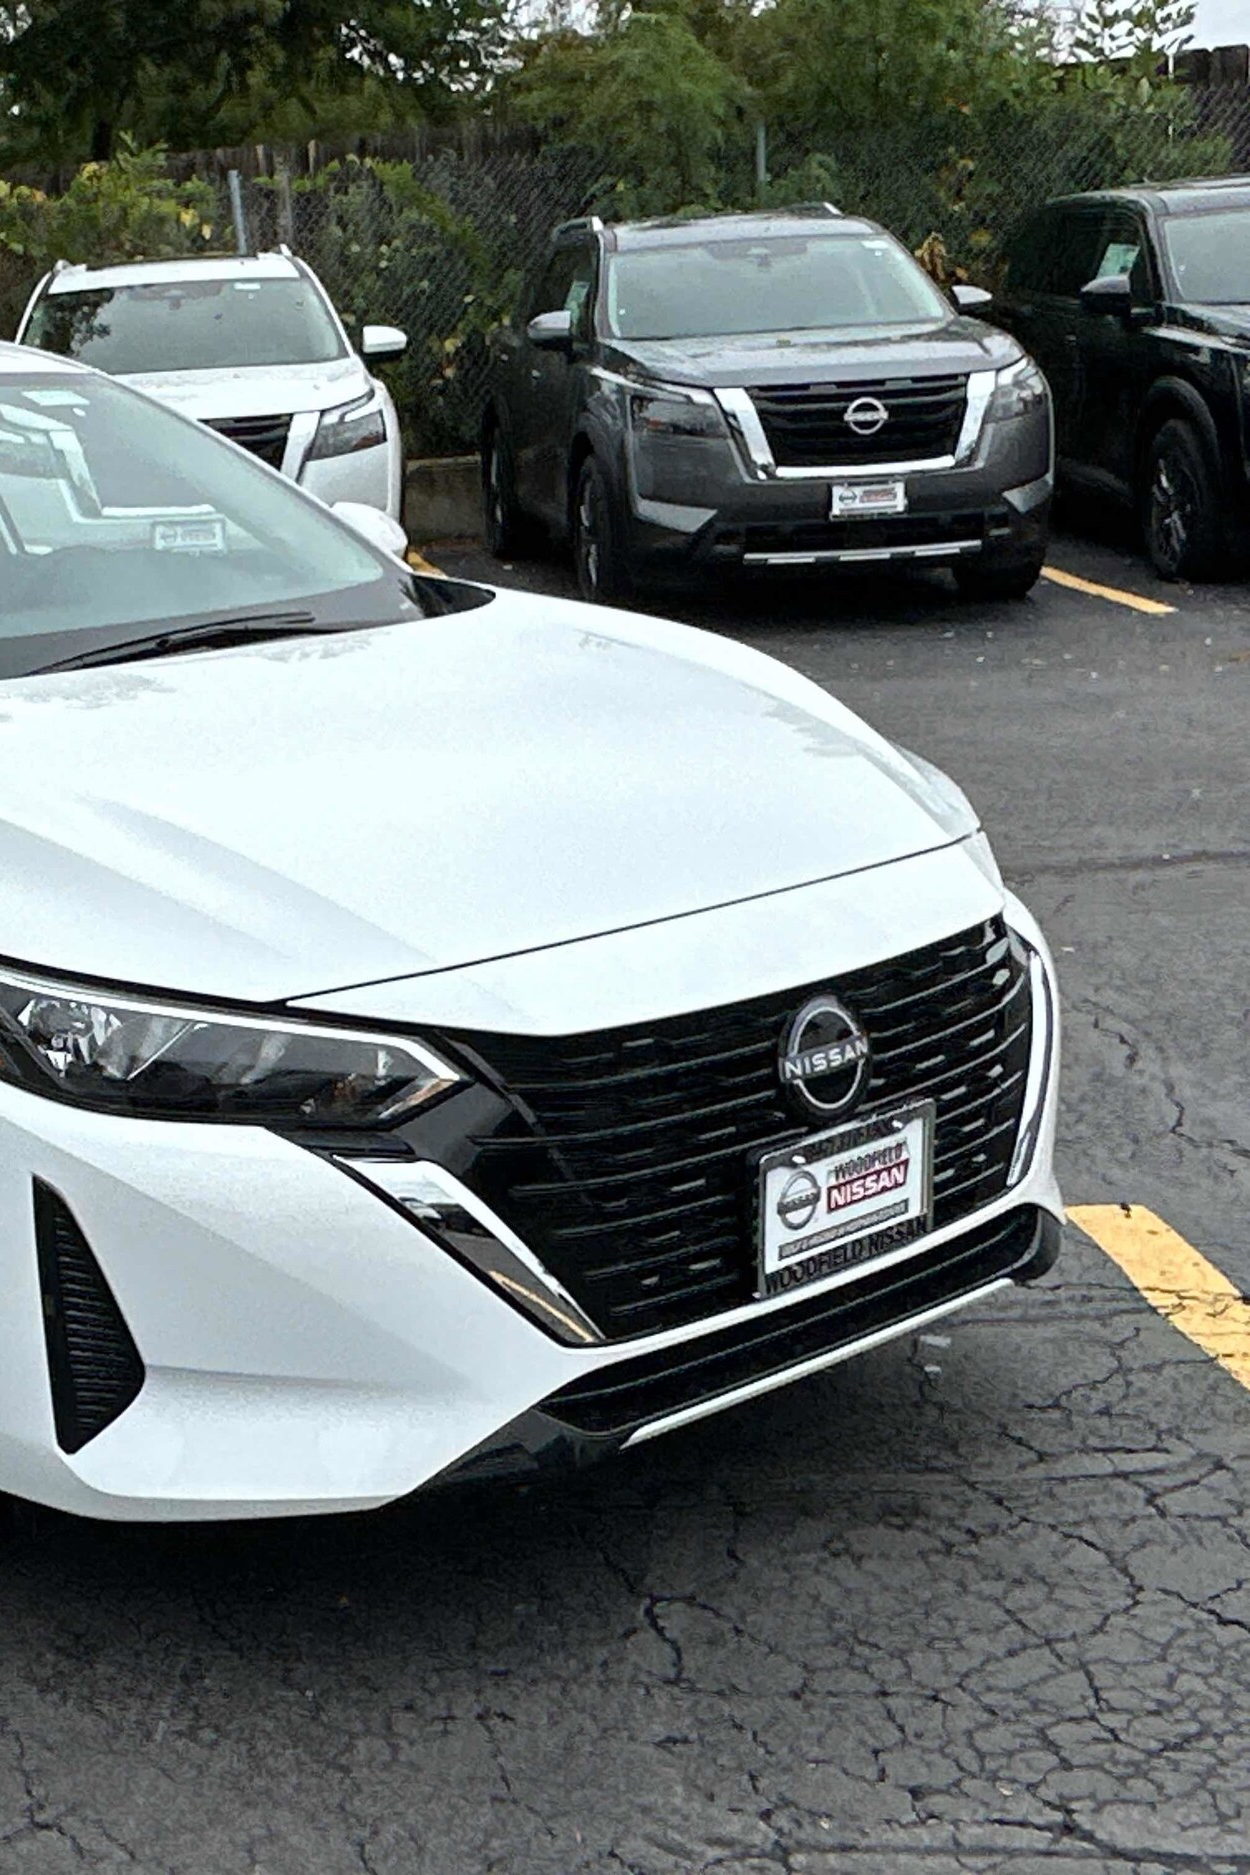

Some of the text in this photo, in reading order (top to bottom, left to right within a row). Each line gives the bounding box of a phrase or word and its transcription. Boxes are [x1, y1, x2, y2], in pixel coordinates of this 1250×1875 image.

[784, 1036, 869, 1080] NISSAN
[830, 1163, 907, 1210] NISSAN
[765, 1241, 865, 1295] WOODFIELD
